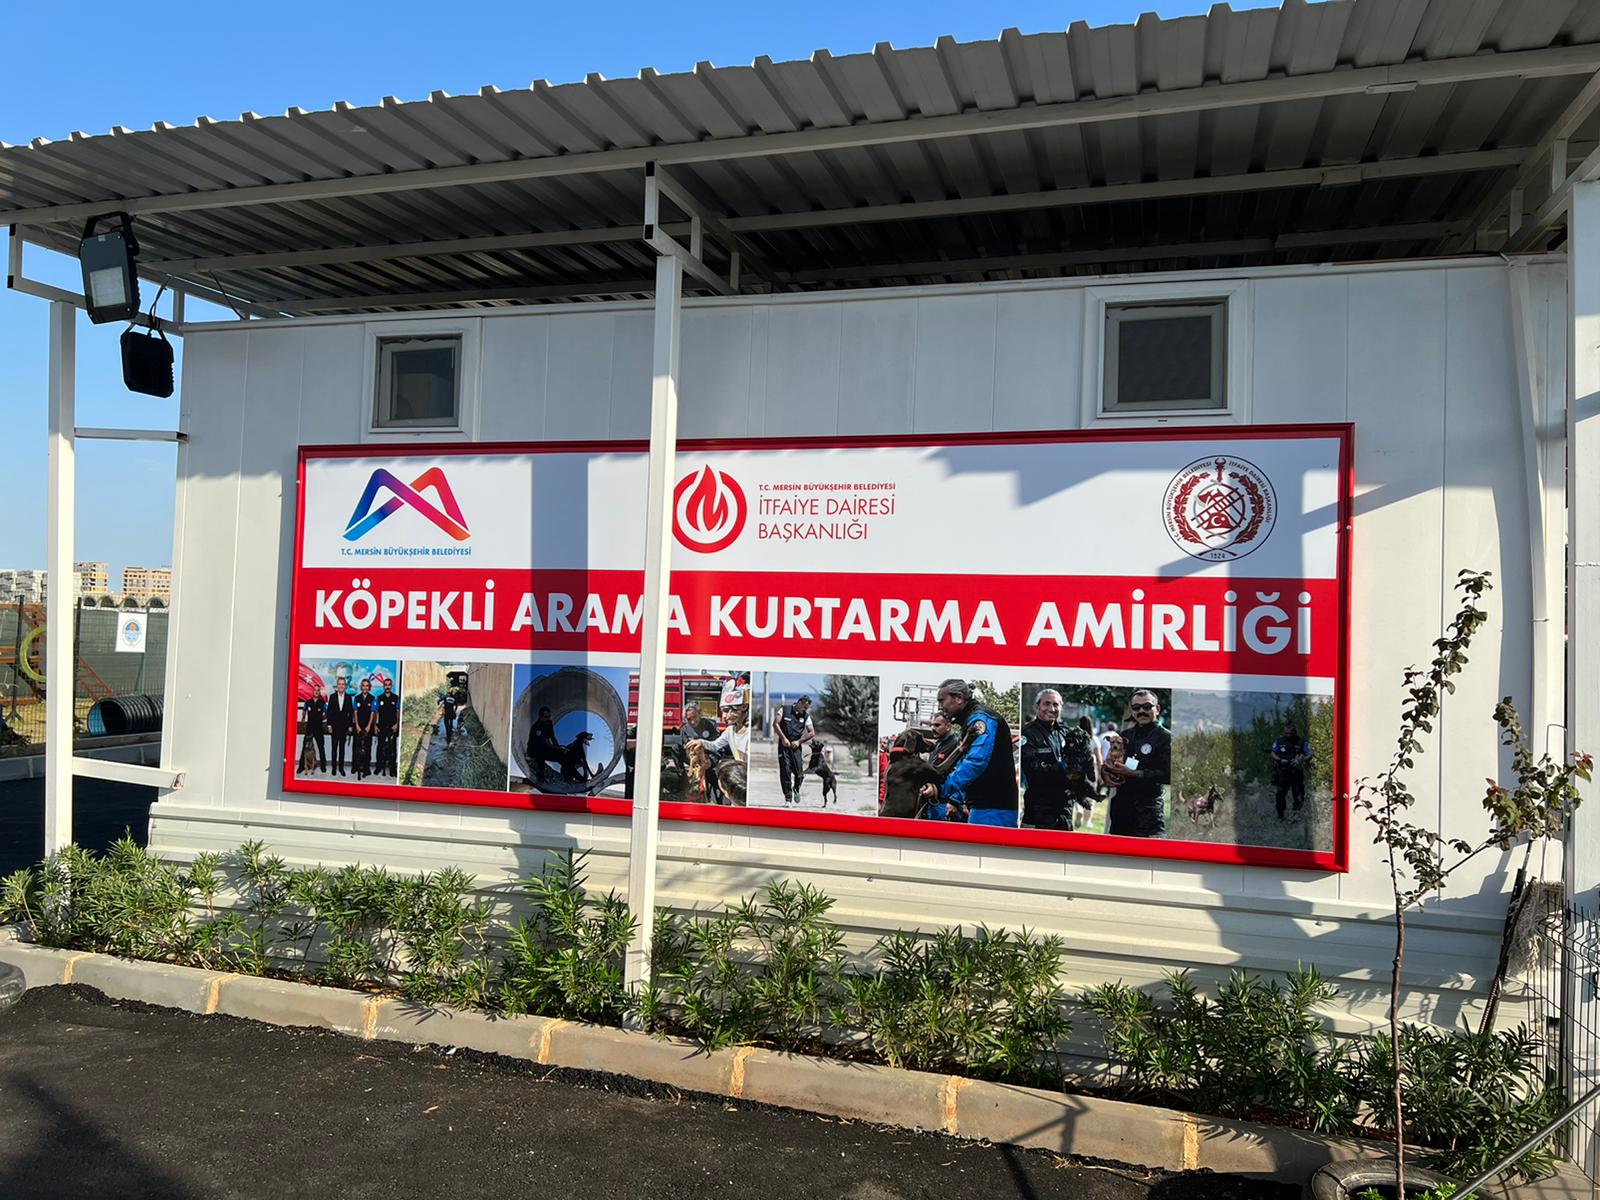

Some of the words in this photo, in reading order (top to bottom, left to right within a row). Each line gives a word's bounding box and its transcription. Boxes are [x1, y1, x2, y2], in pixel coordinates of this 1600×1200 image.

[758, 484, 771, 492] T.C.
[773, 483, 802, 491] MERSİN
[803, 482, 852, 492] BÜYÜKŞEHİR
[853, 482, 896, 491] BELEDİYESİ
[758, 494, 819, 516] İTFAİYE
[826, 493, 895, 516] DAİRESİ
[758, 518, 868, 543] BAŞKANLIĞI
[341, 547, 353, 556] T.C.
[354, 546, 382, 556] MERSİN
[383, 546, 430, 557] BÜYÜKŞEHİR
[431, 546, 472, 556] BELEDİYESİ
[315, 578, 495, 631] KÖPEKLİ
[510, 591, 691, 636] ARAMA
[709, 595, 1007, 645] KURTARMA
[1025, 588, 1312, 655] AMİRLİĞİ
